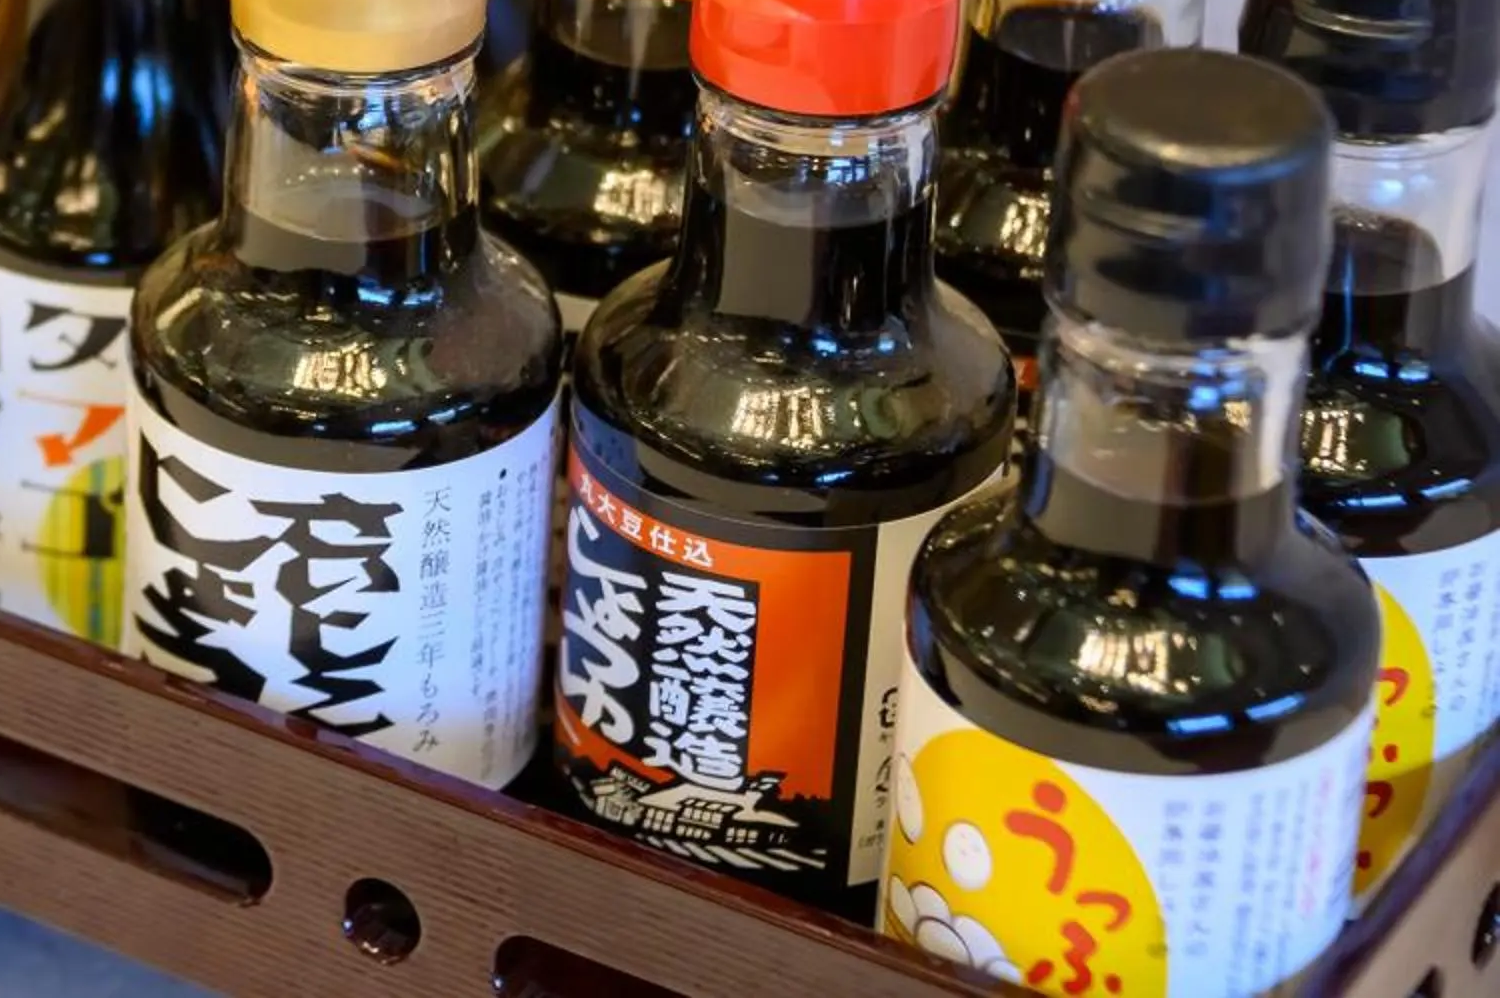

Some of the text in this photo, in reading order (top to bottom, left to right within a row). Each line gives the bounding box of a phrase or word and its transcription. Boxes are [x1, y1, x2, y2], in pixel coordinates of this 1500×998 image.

[133, 425, 281, 704] しょう
[412, 485, 453, 753] 天然醸造三年もろみ
[579, 472, 714, 569] 丸大豆仕込
[641, 570, 758, 792] 天然醸造
